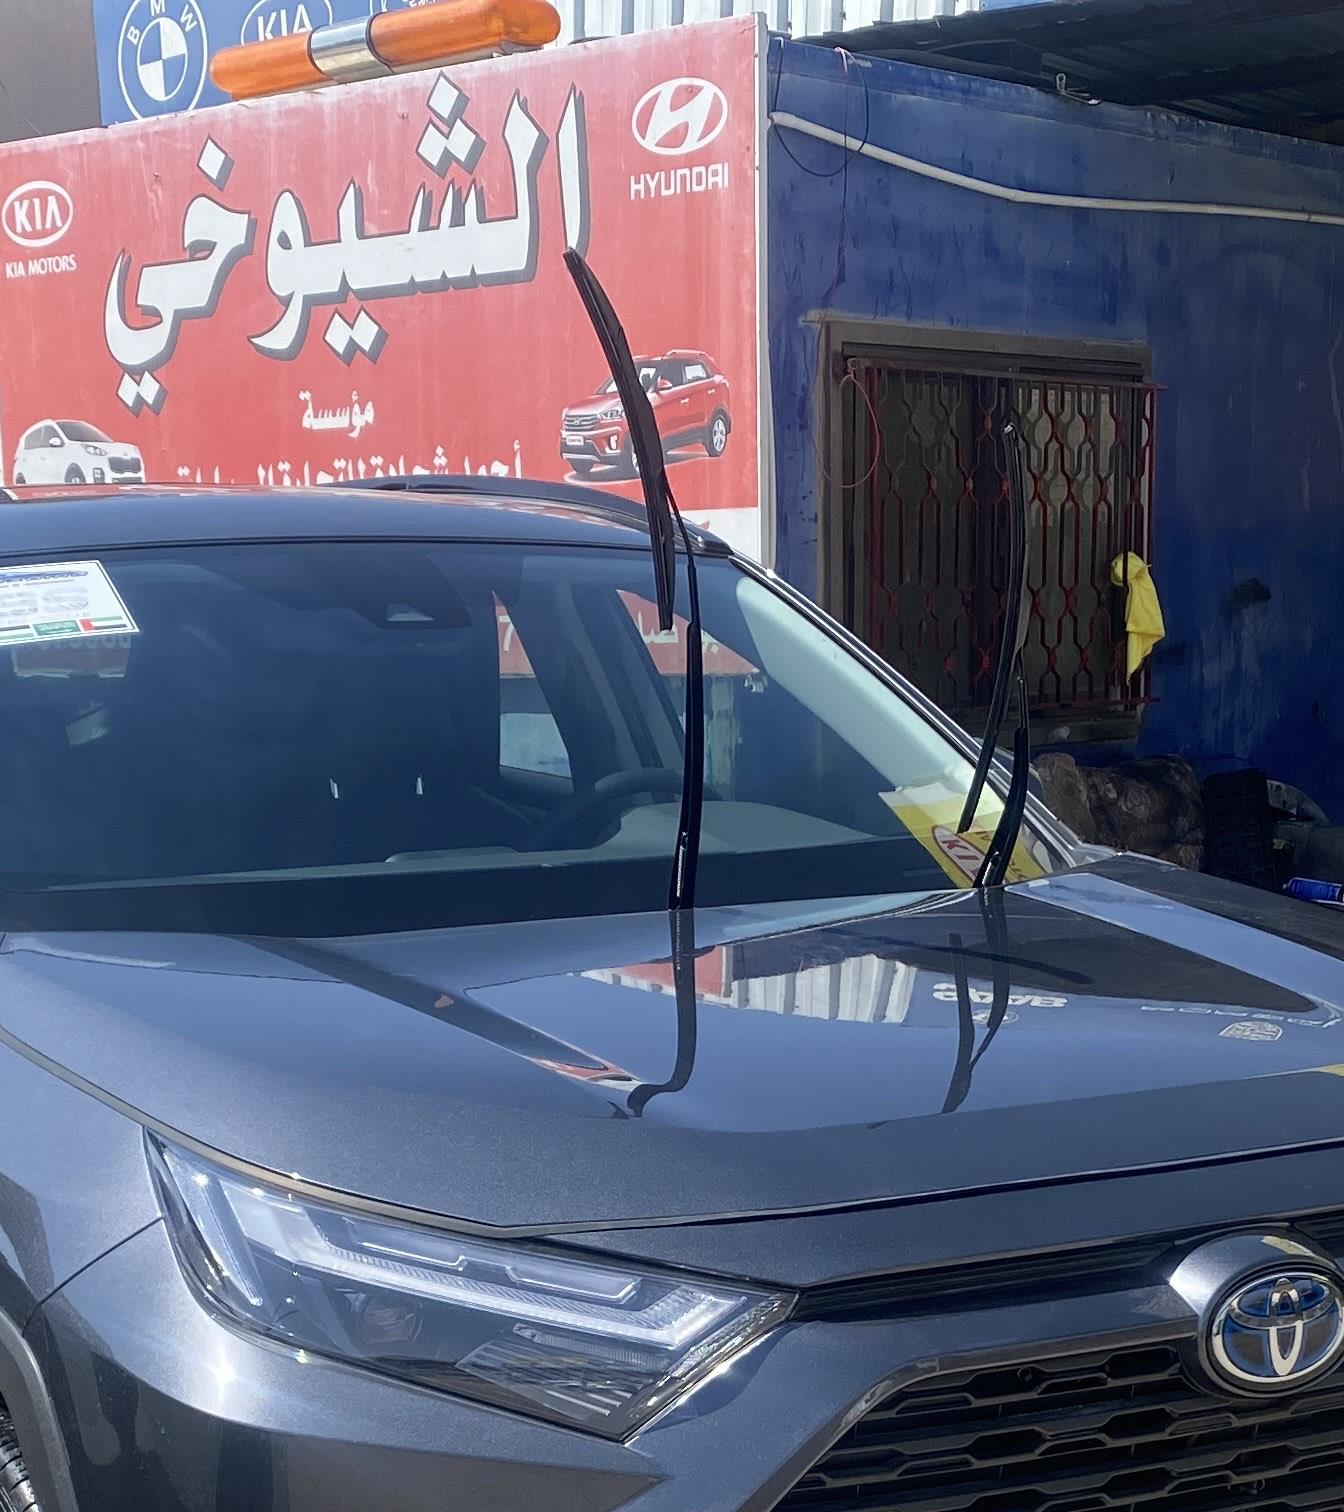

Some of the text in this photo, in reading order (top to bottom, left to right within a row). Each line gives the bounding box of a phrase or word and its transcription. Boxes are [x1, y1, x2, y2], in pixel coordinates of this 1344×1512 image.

[257, 3, 314, 42] KIA
[630, 162, 729, 200] HYUNDAI
[13, 195, 63, 234] KIA
[103, 71, 587, 416] الشيوخي
[5, 253, 77, 279] KIA MOTORS
[298, 390, 374, 438] مؤسسة
